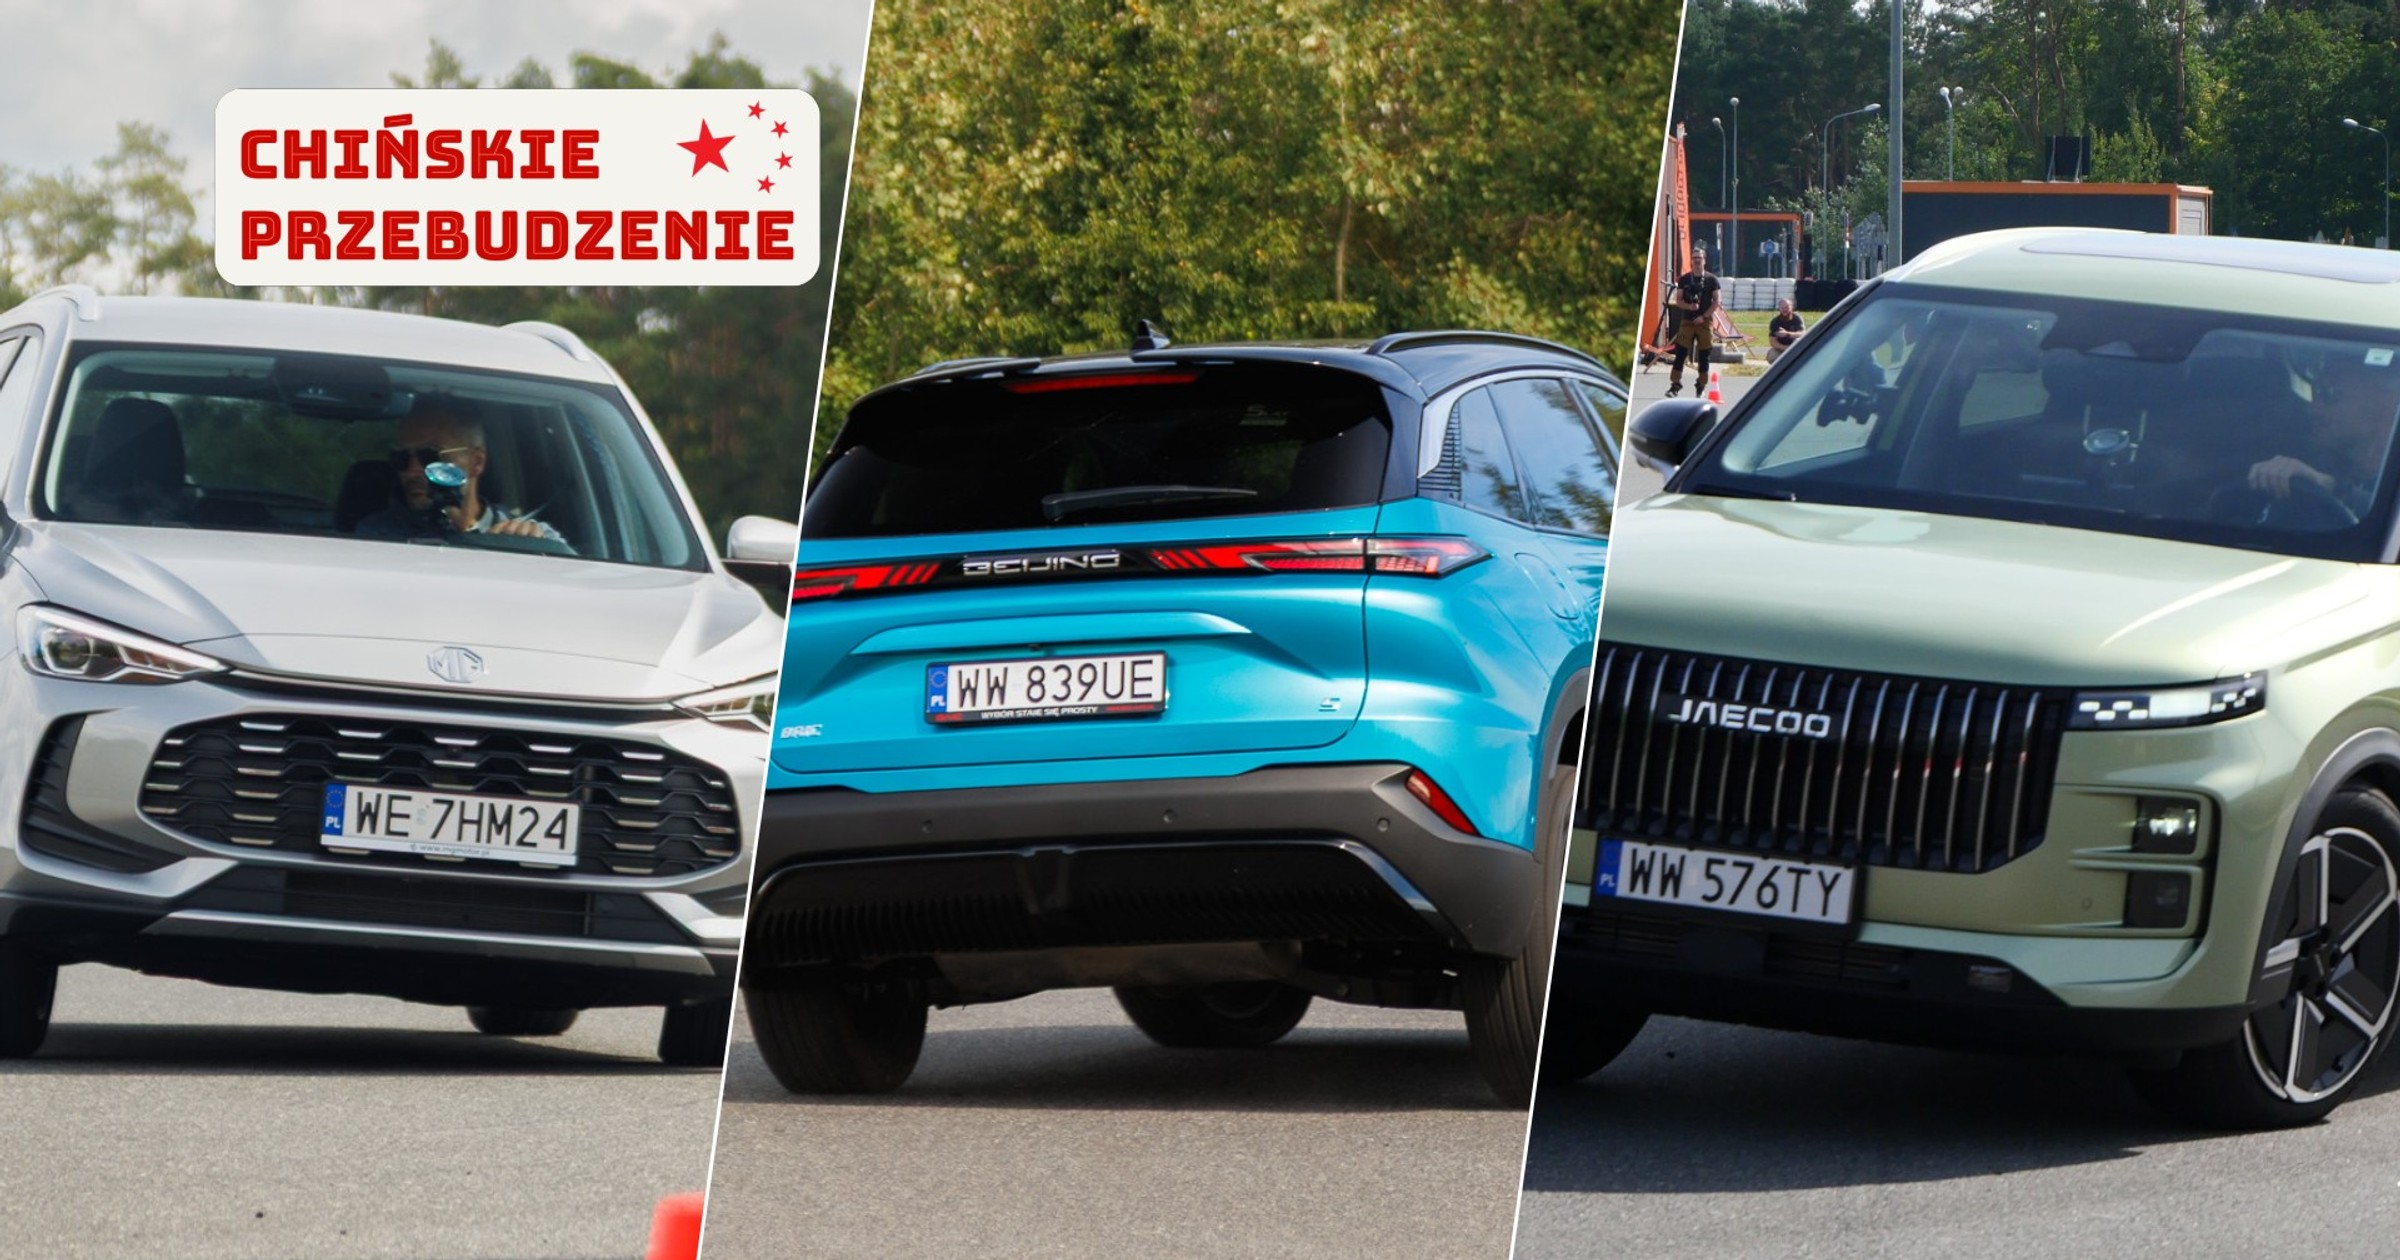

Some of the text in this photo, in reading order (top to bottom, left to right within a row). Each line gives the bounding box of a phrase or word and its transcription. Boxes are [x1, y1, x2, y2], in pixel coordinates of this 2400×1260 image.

[963, 553, 1120, 576] BEIJING
[957, 659, 1154, 708] WW 839UE
[930, 695, 946, 707] PL
[981, 709, 1015, 720] WYBÓR
[1061, 705, 1099, 716] PROSTY
[1667, 699, 1831, 738] JAECOO
[325, 815, 341, 829] PL
[356, 791, 569, 850] WE 7HM24
[1600, 873, 1616, 887] PL
[1629, 848, 1842, 917] WW 576TY
